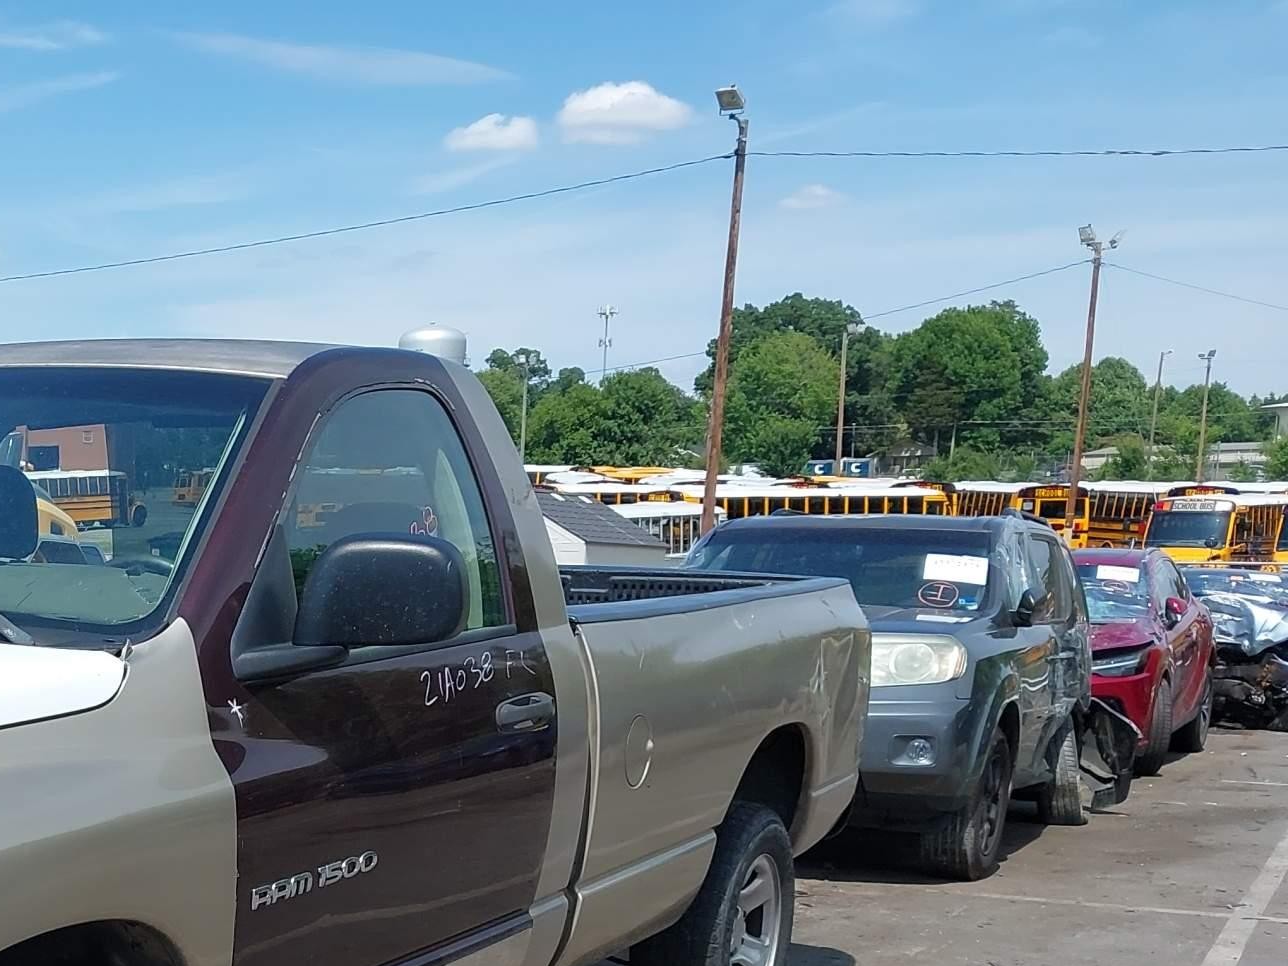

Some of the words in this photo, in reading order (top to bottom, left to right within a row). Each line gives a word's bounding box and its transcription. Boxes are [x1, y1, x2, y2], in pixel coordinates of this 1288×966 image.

[1172, 501, 1197, 510] SCHOOL
[1199, 501, 1215, 510] BUS
[251, 871, 314, 911] RAM
[317, 850, 379, 888] 1500
